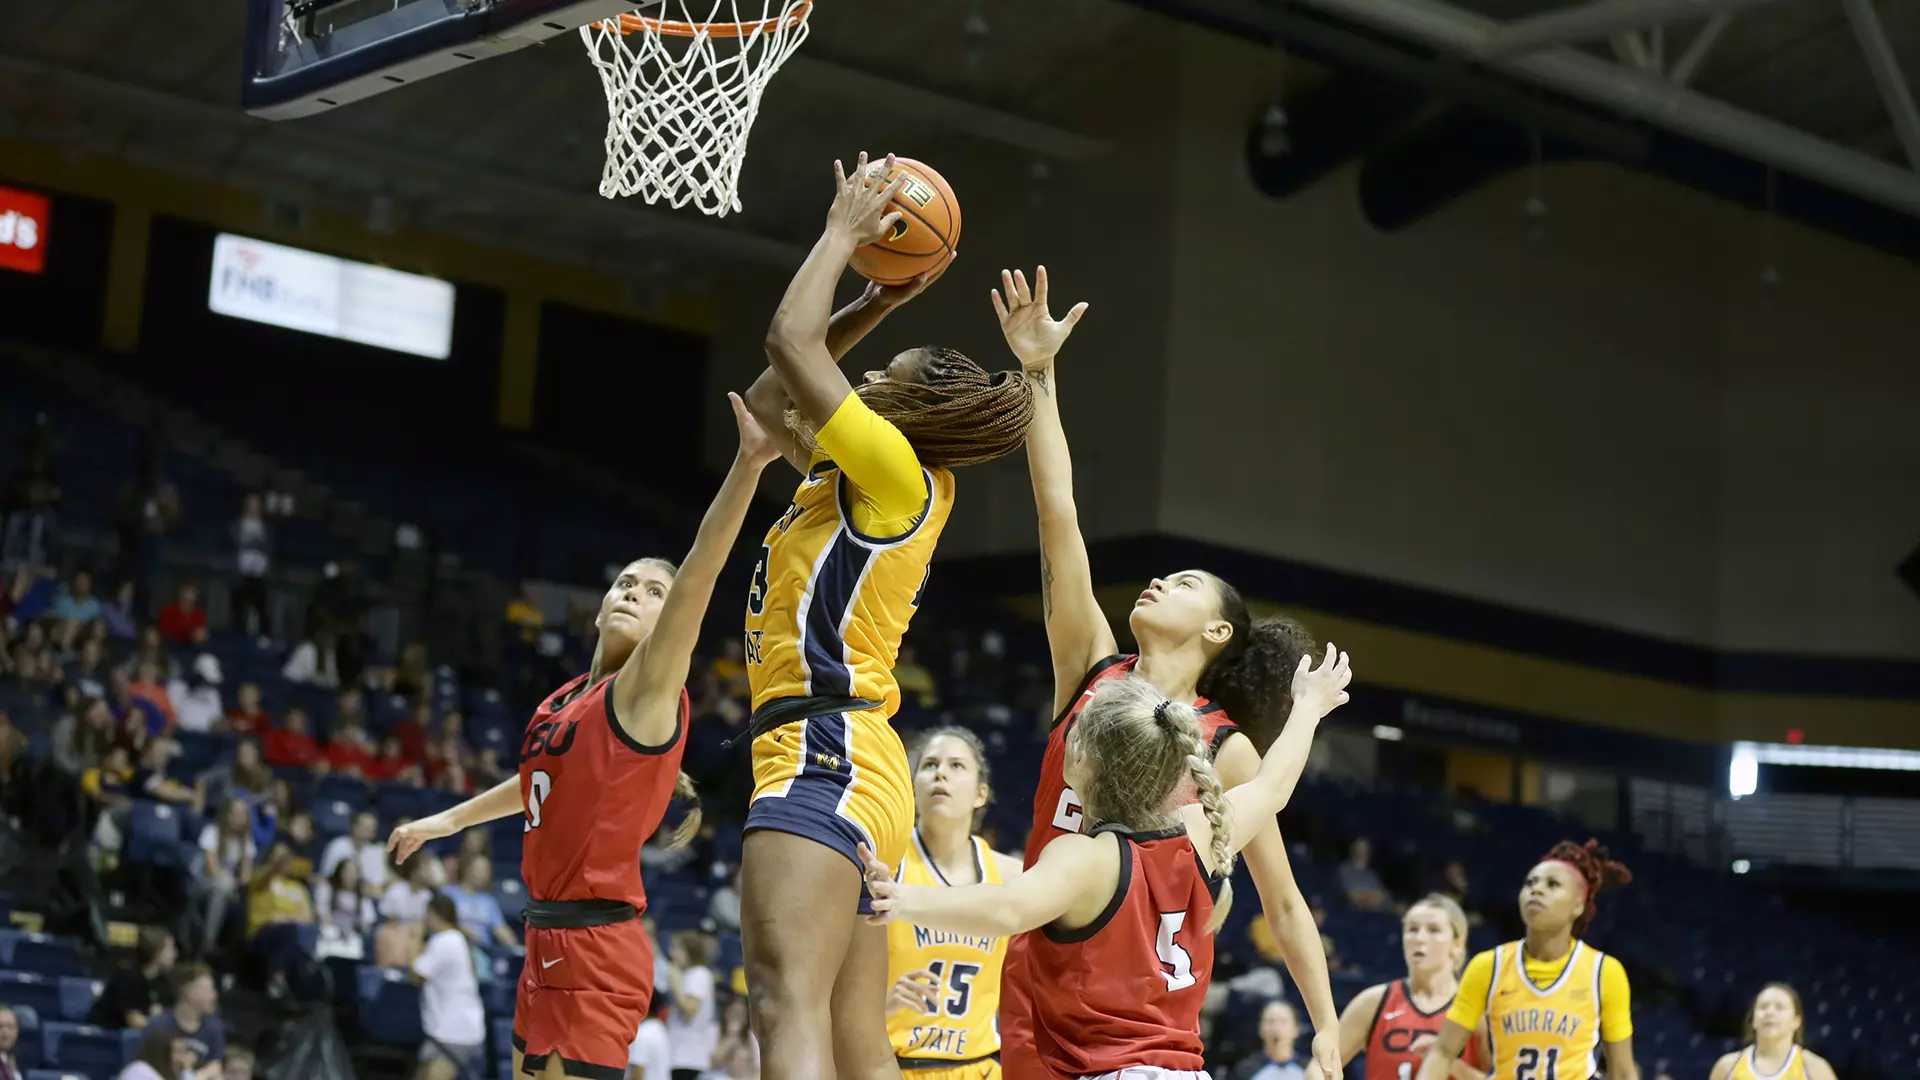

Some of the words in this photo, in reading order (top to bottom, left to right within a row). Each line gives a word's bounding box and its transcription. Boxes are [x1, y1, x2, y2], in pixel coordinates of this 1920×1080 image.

[1154, 910, 1197, 992] 5
[1502, 1007, 1583, 1040] MURRAY
[907, 1025, 970, 1057] STATE
[1513, 1045, 1562, 1080] 21
